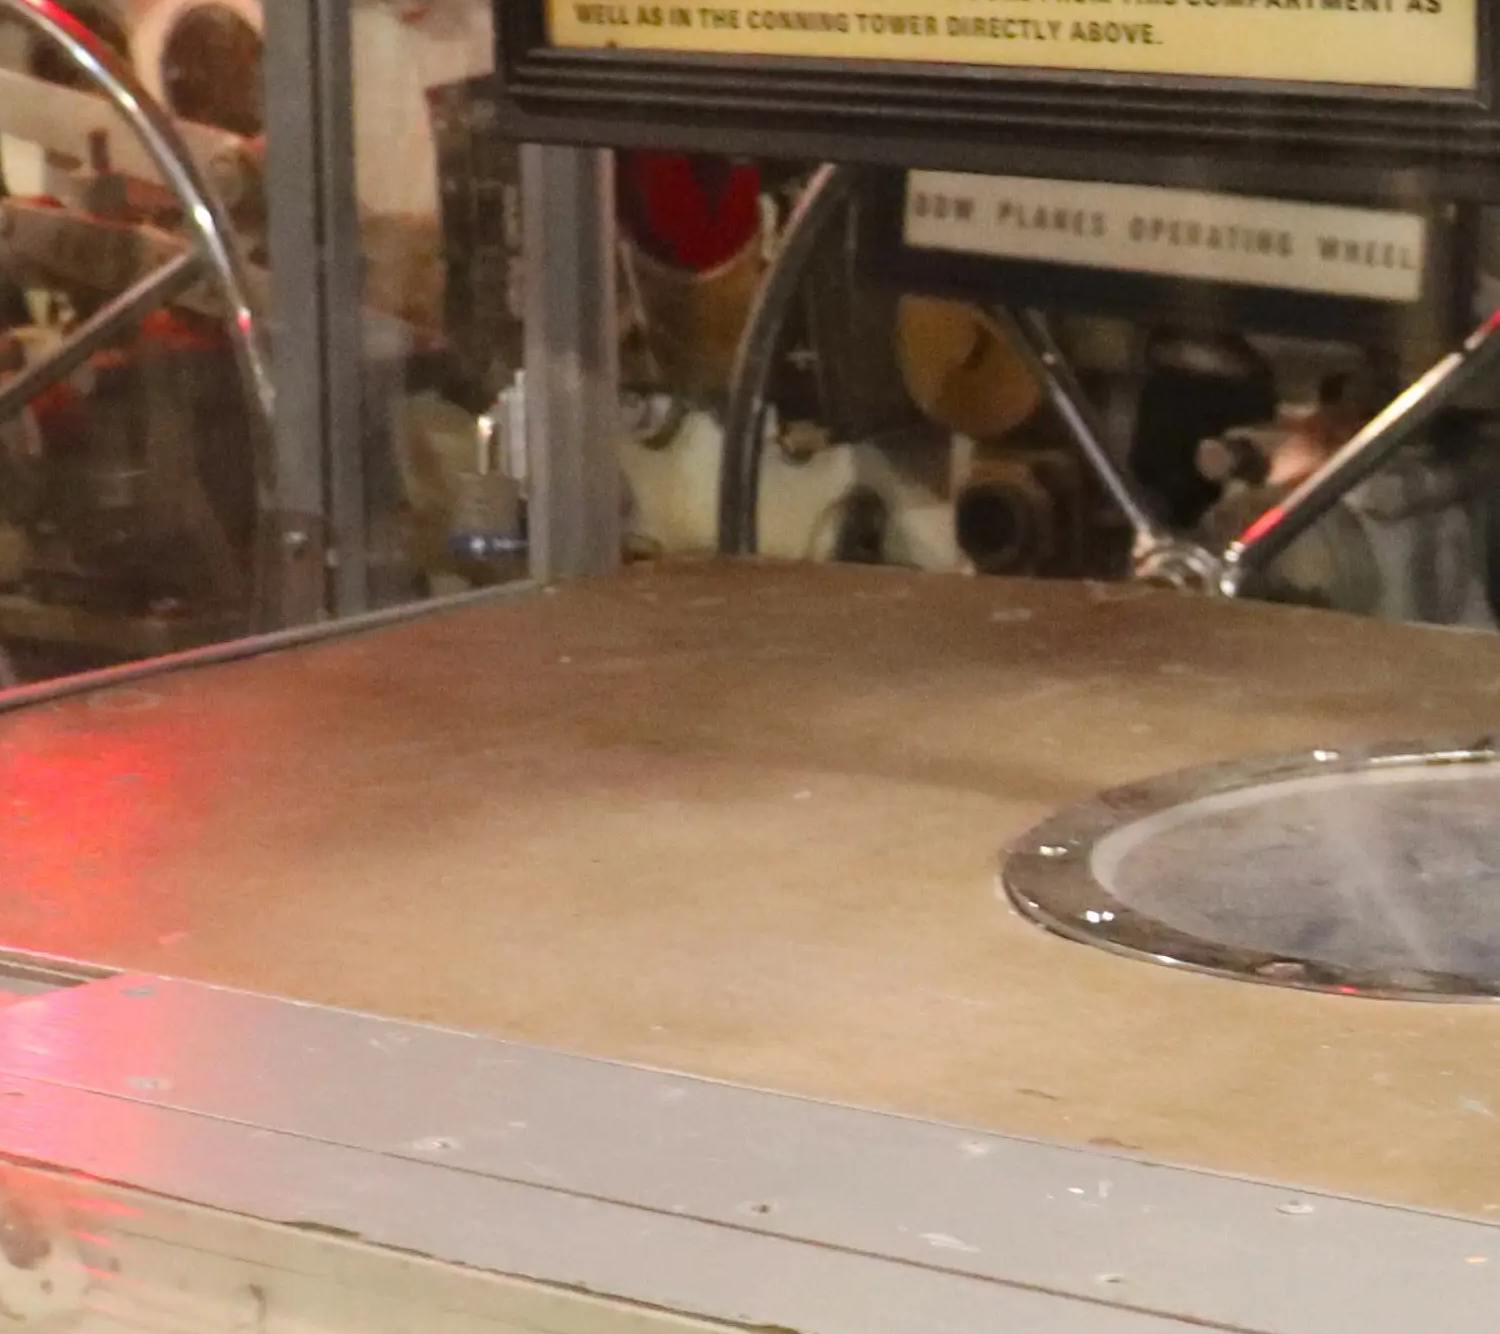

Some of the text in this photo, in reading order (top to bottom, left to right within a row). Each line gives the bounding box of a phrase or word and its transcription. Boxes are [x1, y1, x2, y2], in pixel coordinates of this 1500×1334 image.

[573, 3, 1164, 46] WELL AS IN THE CONNING TOWER DIRECTLY ABOVE.
[998, 198, 1109, 240] PLANES
[1128, 214, 1295, 260] OPERATING
[1316, 233, 1414, 272] WHEEL
